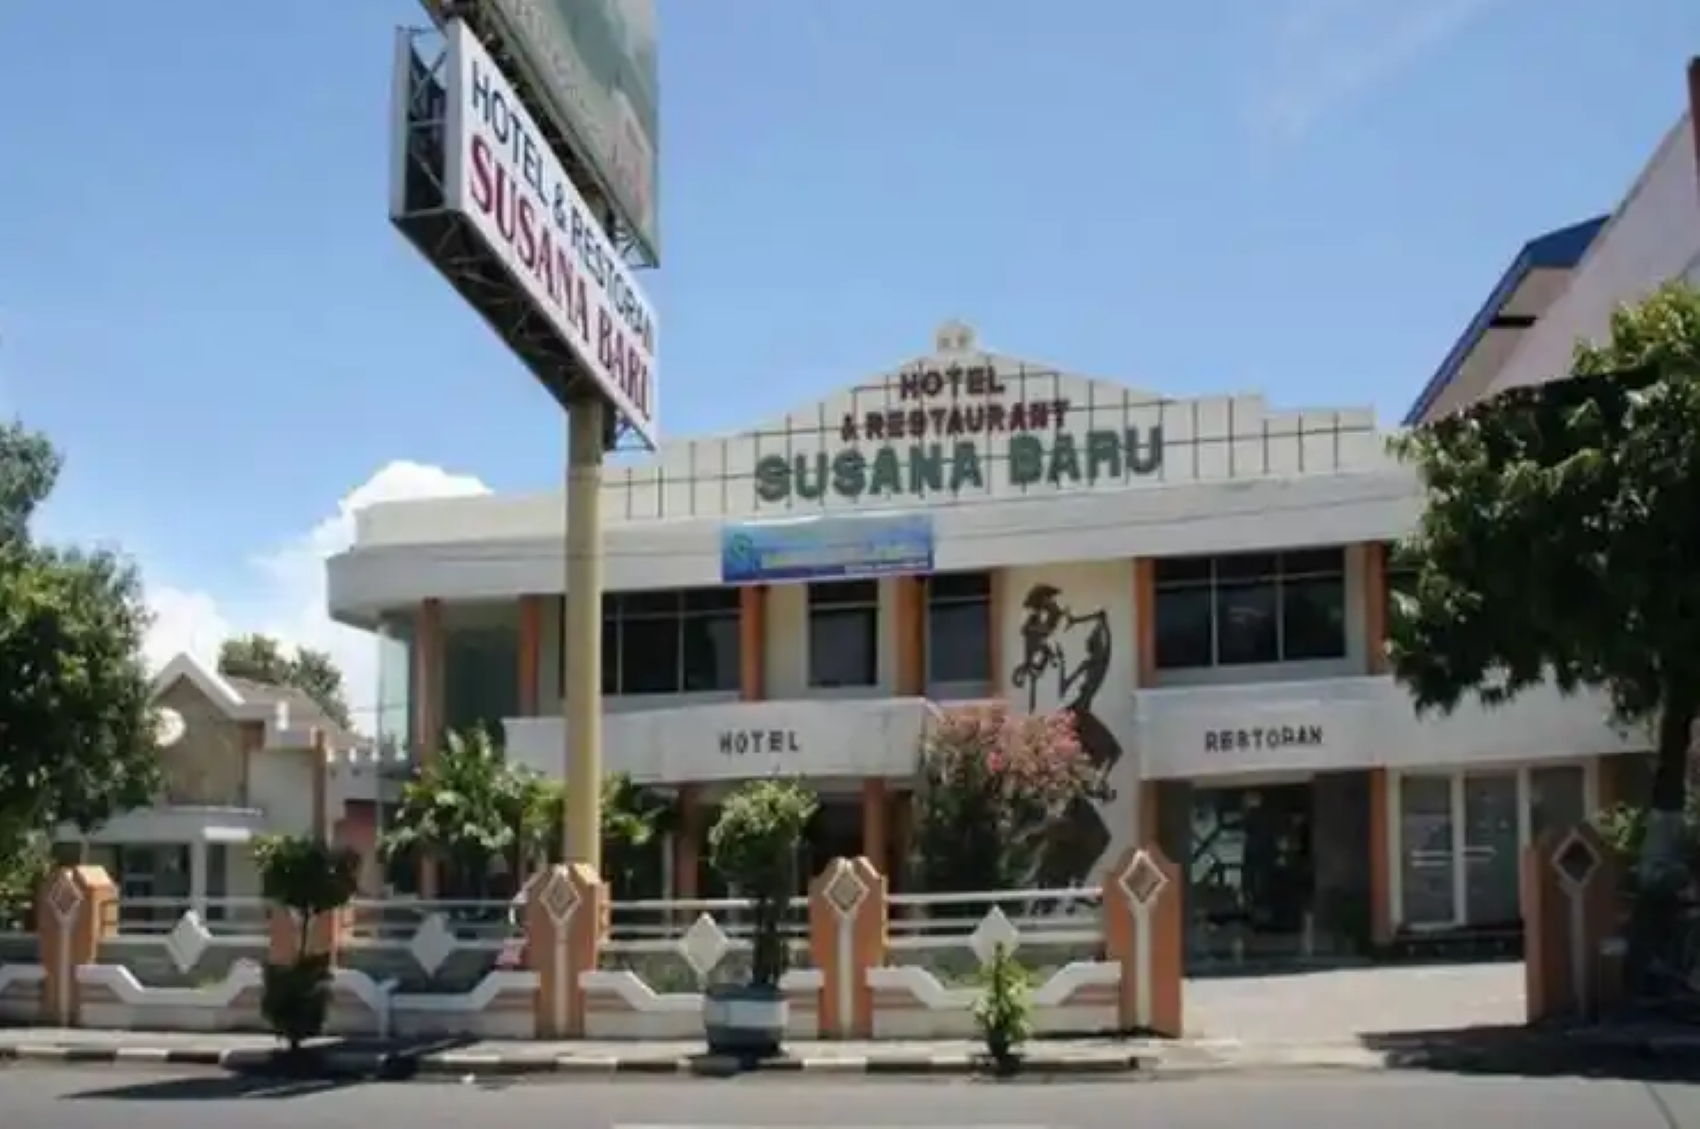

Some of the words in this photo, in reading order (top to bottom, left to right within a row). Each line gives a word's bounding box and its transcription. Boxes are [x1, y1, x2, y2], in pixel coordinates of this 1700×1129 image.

[472, 61, 549, 207] HOTEL
[553, 183, 571, 232] &
[471, 134, 590, 343] SUSANA
[901, 366, 1005, 400] HOTEL
[866, 399, 1069, 440] RESTAURANT
[754, 441, 983, 502] SUSANA
[1009, 427, 1163, 485] BARU
[720, 730, 800, 755] HOTEL
[1204, 725, 1323, 753] RESTORAN
